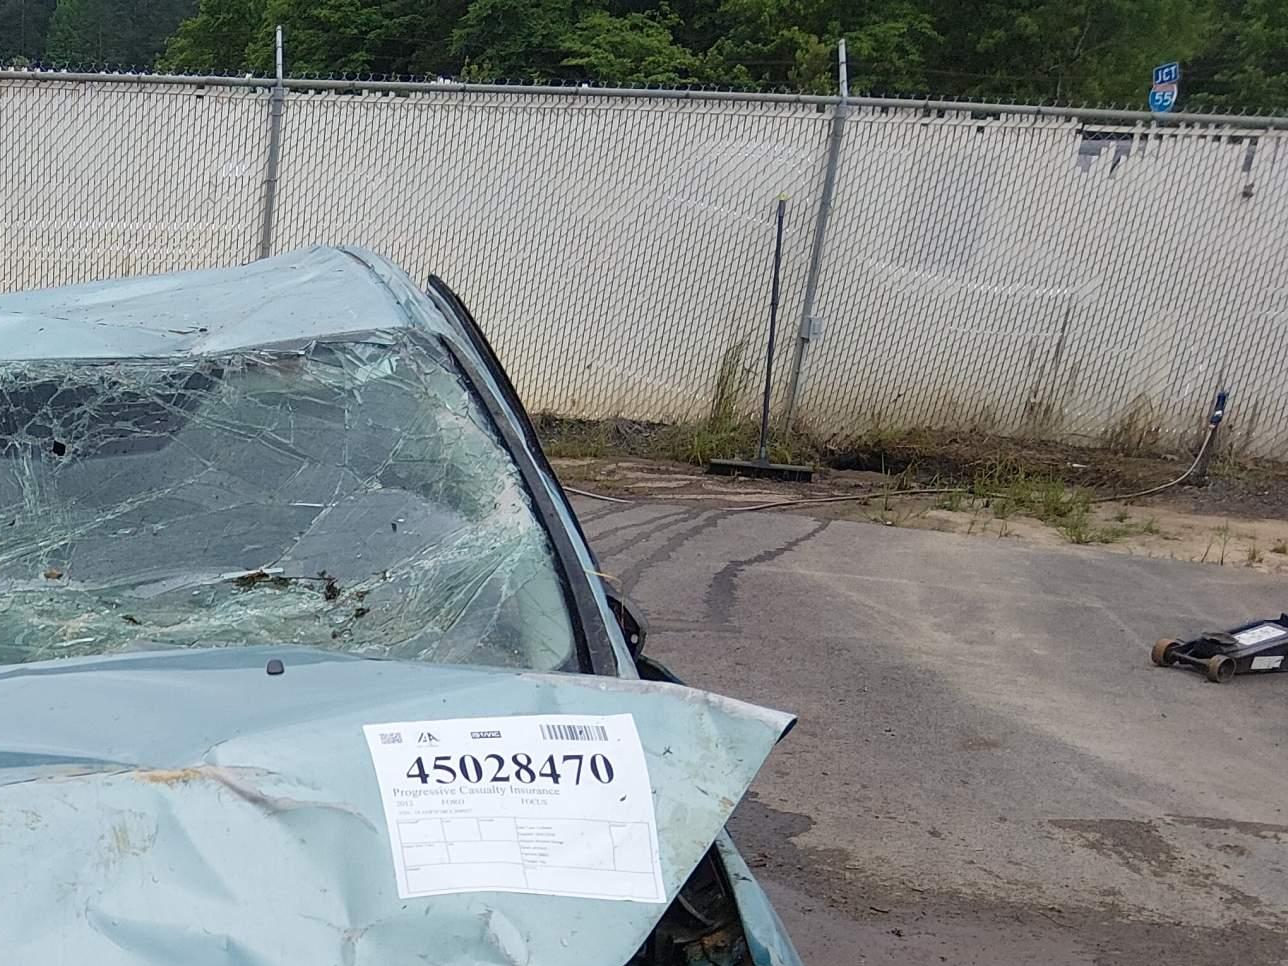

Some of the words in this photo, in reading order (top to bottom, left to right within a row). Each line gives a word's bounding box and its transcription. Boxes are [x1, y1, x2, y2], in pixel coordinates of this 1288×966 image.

[1157, 66, 1177, 83] JCT
[1154, 92, 1174, 105] 55
[406, 753, 615, 786] 45028470
[393, 787, 456, 798] Progressive
[459, 786, 506, 797] Casualty
[510, 785, 560, 796] Insurance
